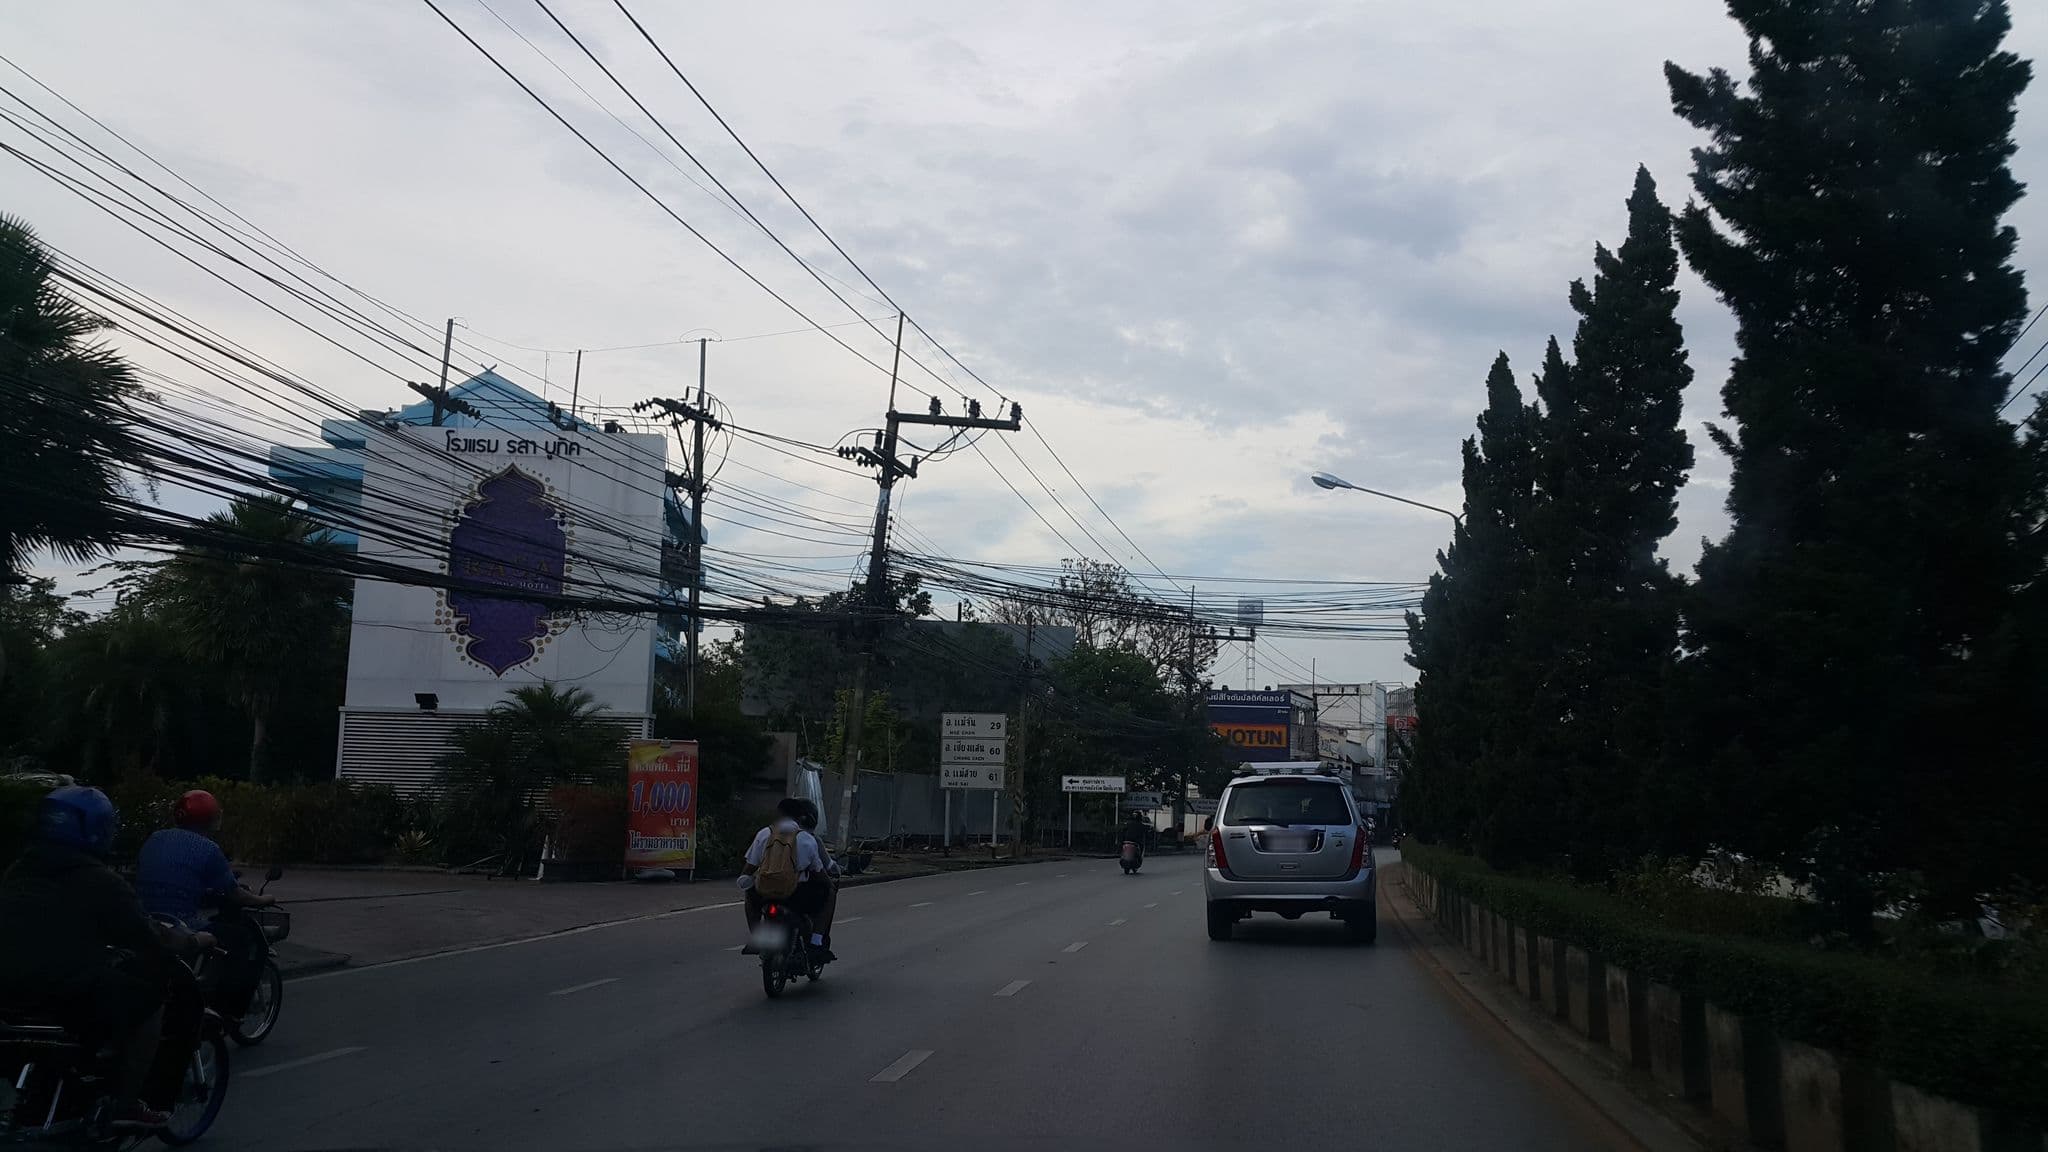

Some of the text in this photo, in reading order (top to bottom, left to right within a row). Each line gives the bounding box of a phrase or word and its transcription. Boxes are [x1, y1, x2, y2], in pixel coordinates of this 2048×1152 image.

[445, 429, 499, 454] โรงแรม
[506, 438, 537, 454] รสา
[990, 722, 1001, 730] 29
[953, 740, 985, 752] เชียงแสน
[989, 747, 1001, 755] 60
[953, 767, 978, 778] แม่สาย
[988, 772, 998, 781] 61
[632, 780, 692, 817] 1,000
[670, 817, 689, 826] บาท
